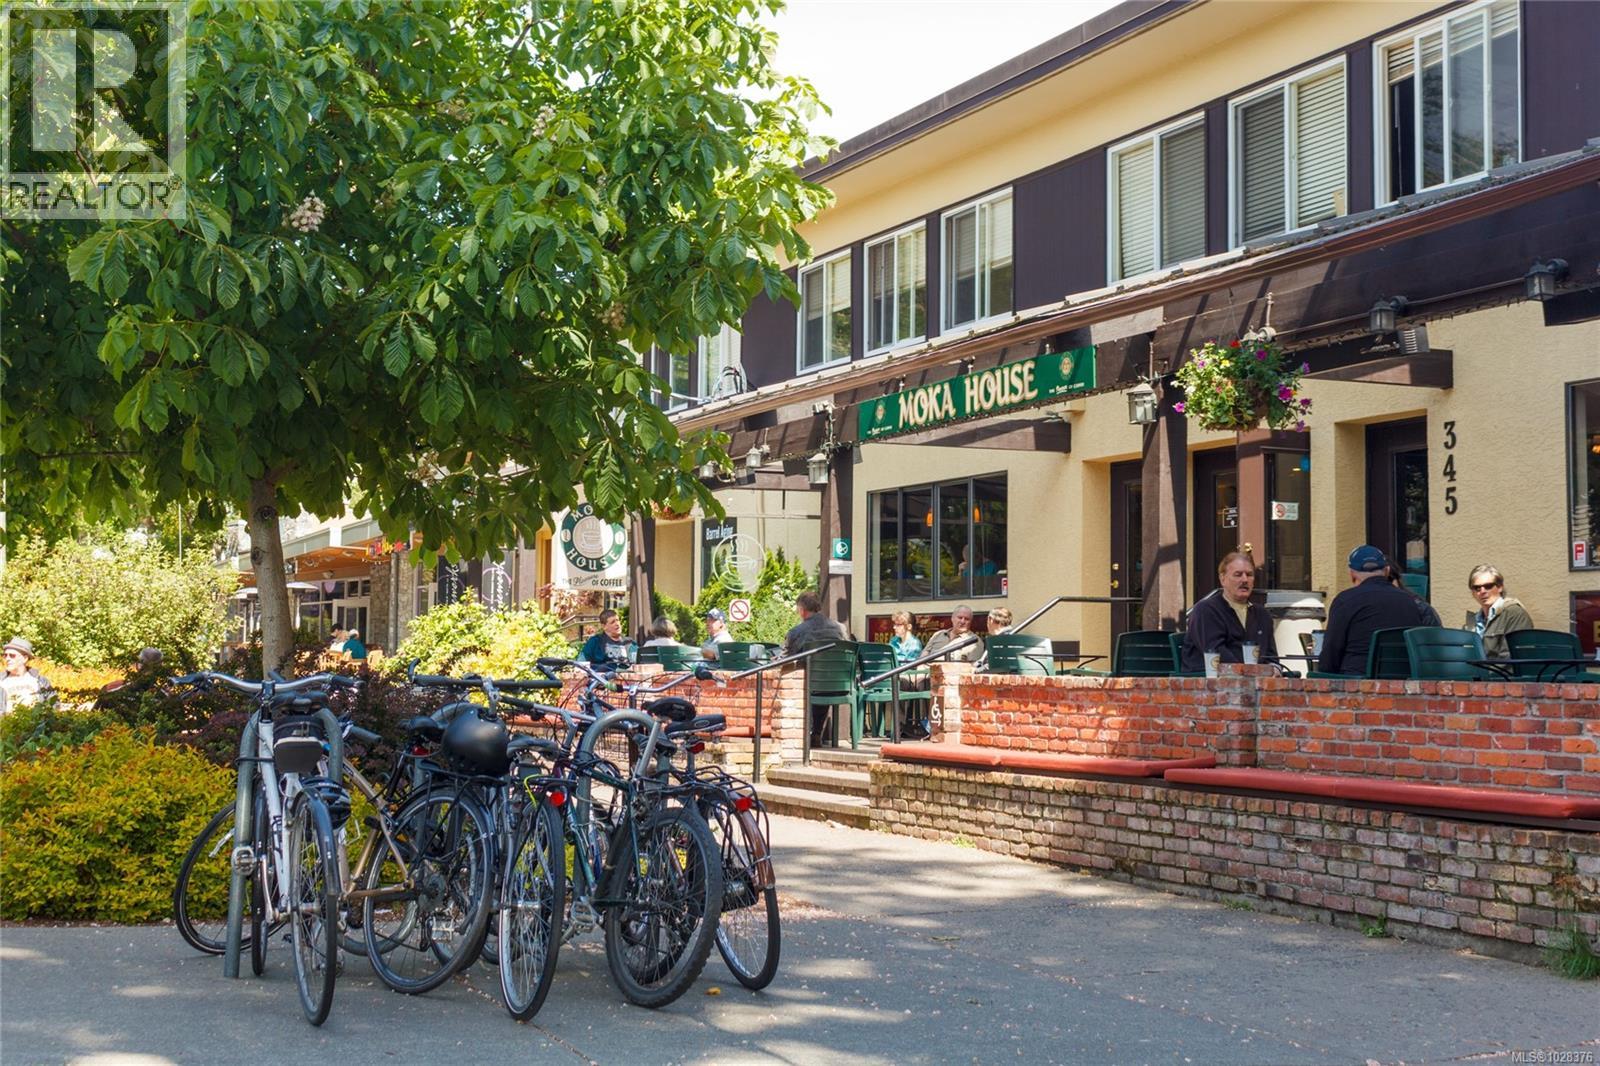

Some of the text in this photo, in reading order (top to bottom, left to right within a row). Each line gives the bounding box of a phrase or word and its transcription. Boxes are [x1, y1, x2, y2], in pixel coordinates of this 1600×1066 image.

[898, 382, 956, 429] MOKA
[964, 360, 1039, 414] HOUSE
[1443, 420, 1458, 515] 345
[571, 504, 594, 522] MO
[566, 548, 619, 571] HOUSE
[600, 578, 622, 587] COFFEE
